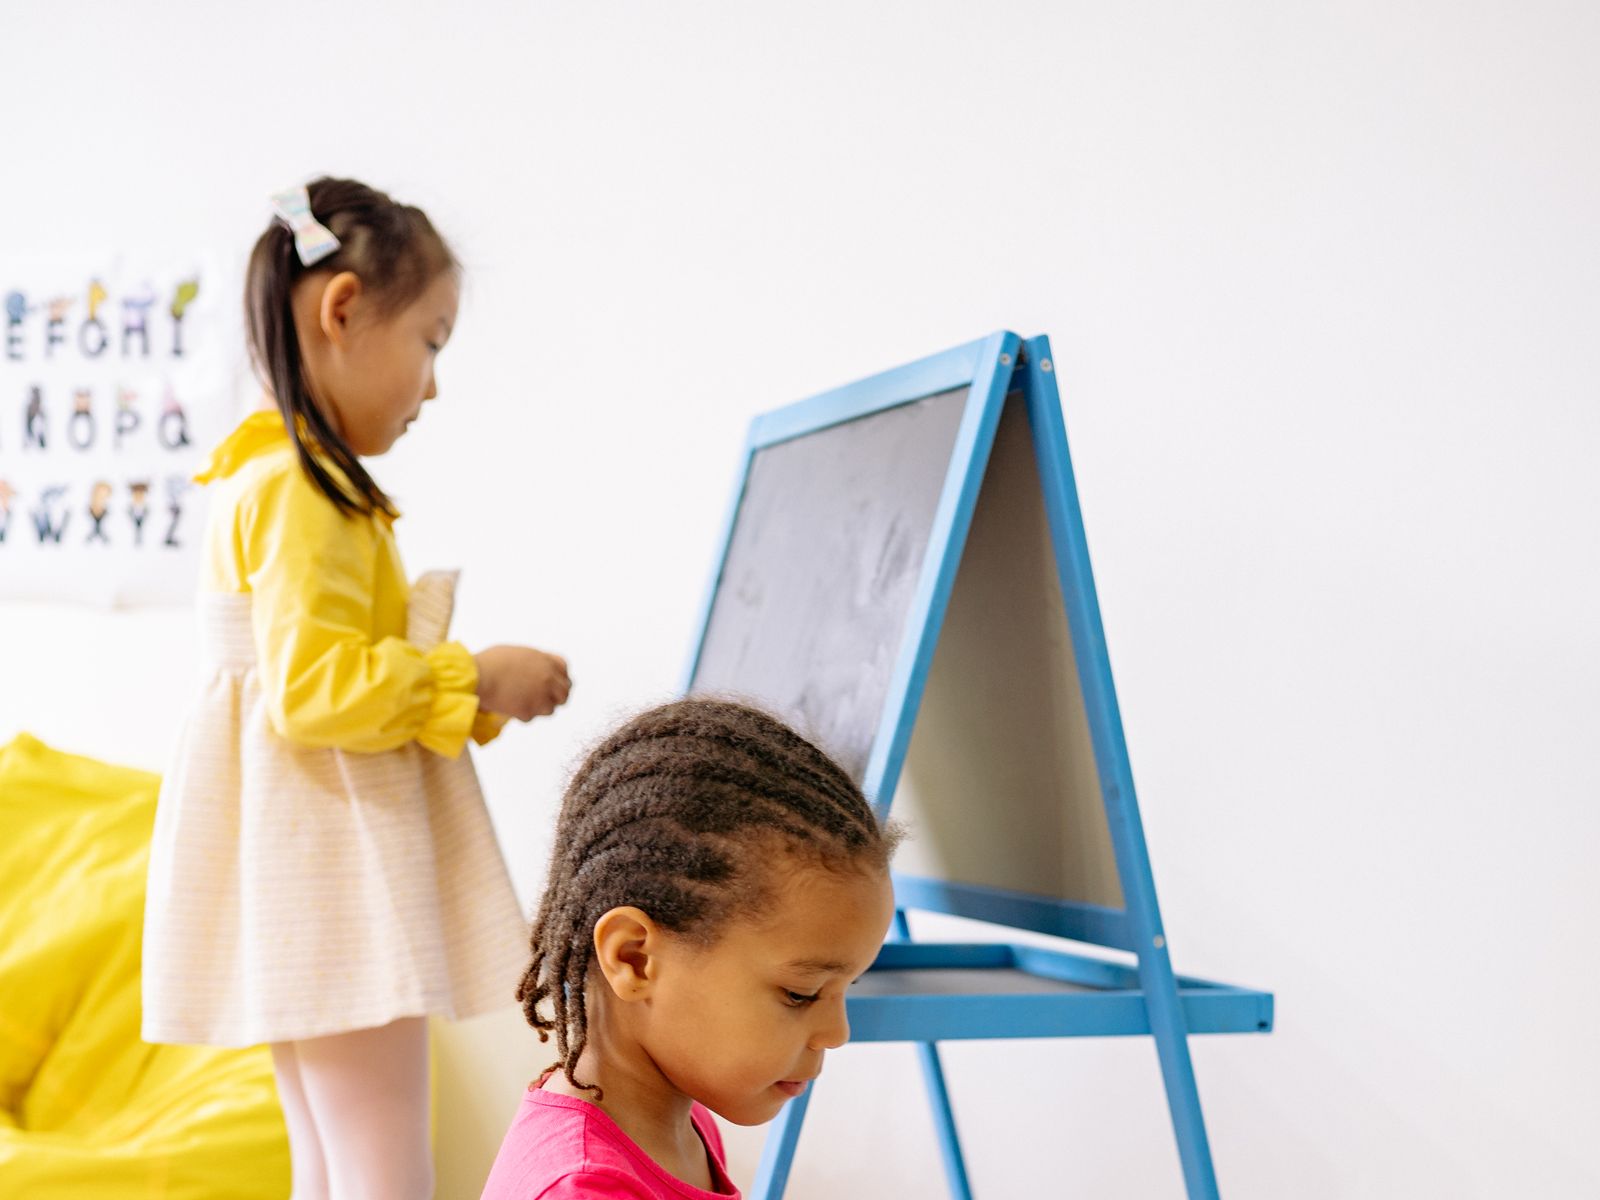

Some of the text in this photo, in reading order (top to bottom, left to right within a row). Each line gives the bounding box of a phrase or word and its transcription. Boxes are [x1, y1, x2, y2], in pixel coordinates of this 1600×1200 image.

[44, 318, 64, 358] F
[68, 410, 97, 449] O
[114, 410, 140, 450] P
[32, 508, 70, 544] W
[86, 506, 109, 544] X
[129, 506, 149, 546] Y
